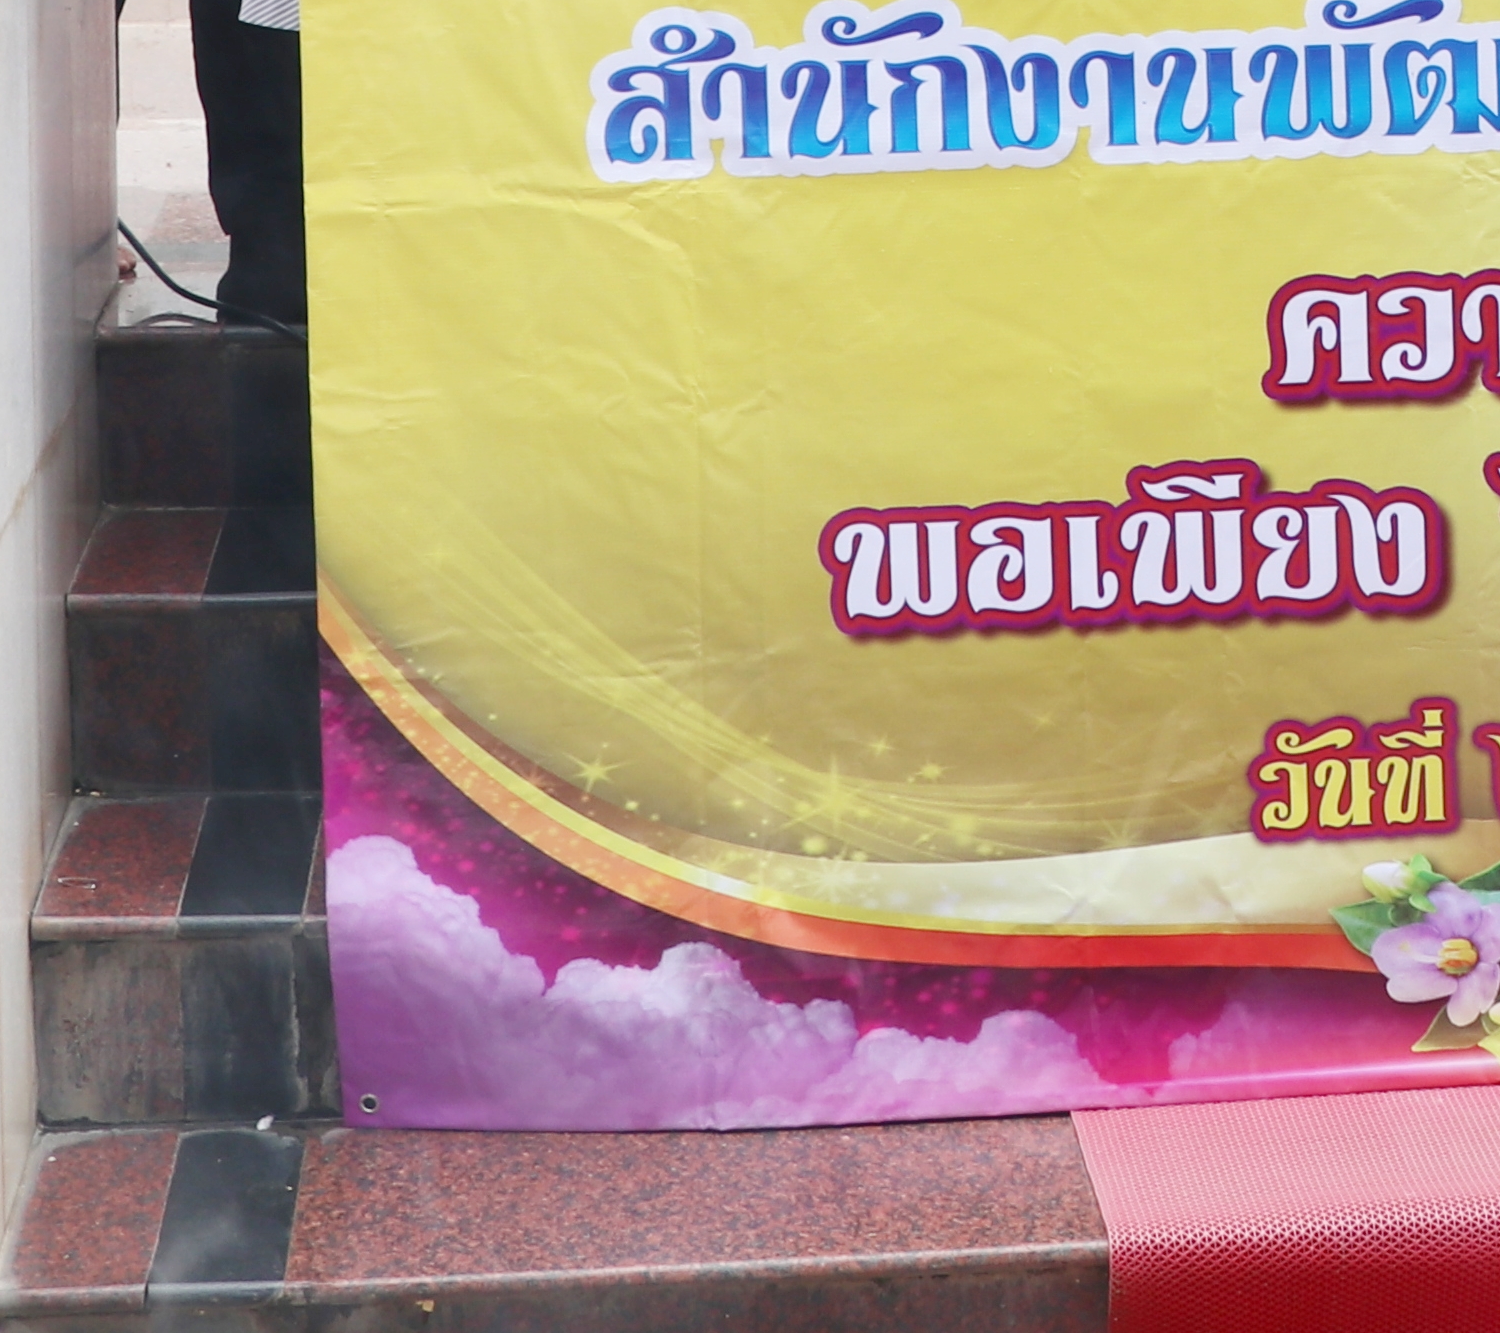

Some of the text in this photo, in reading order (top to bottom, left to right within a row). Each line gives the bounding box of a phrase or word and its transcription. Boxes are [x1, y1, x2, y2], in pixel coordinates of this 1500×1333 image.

[831, 471, 1428, 620] พอเพียง
[1257, 707, 1448, 832] วันที่
